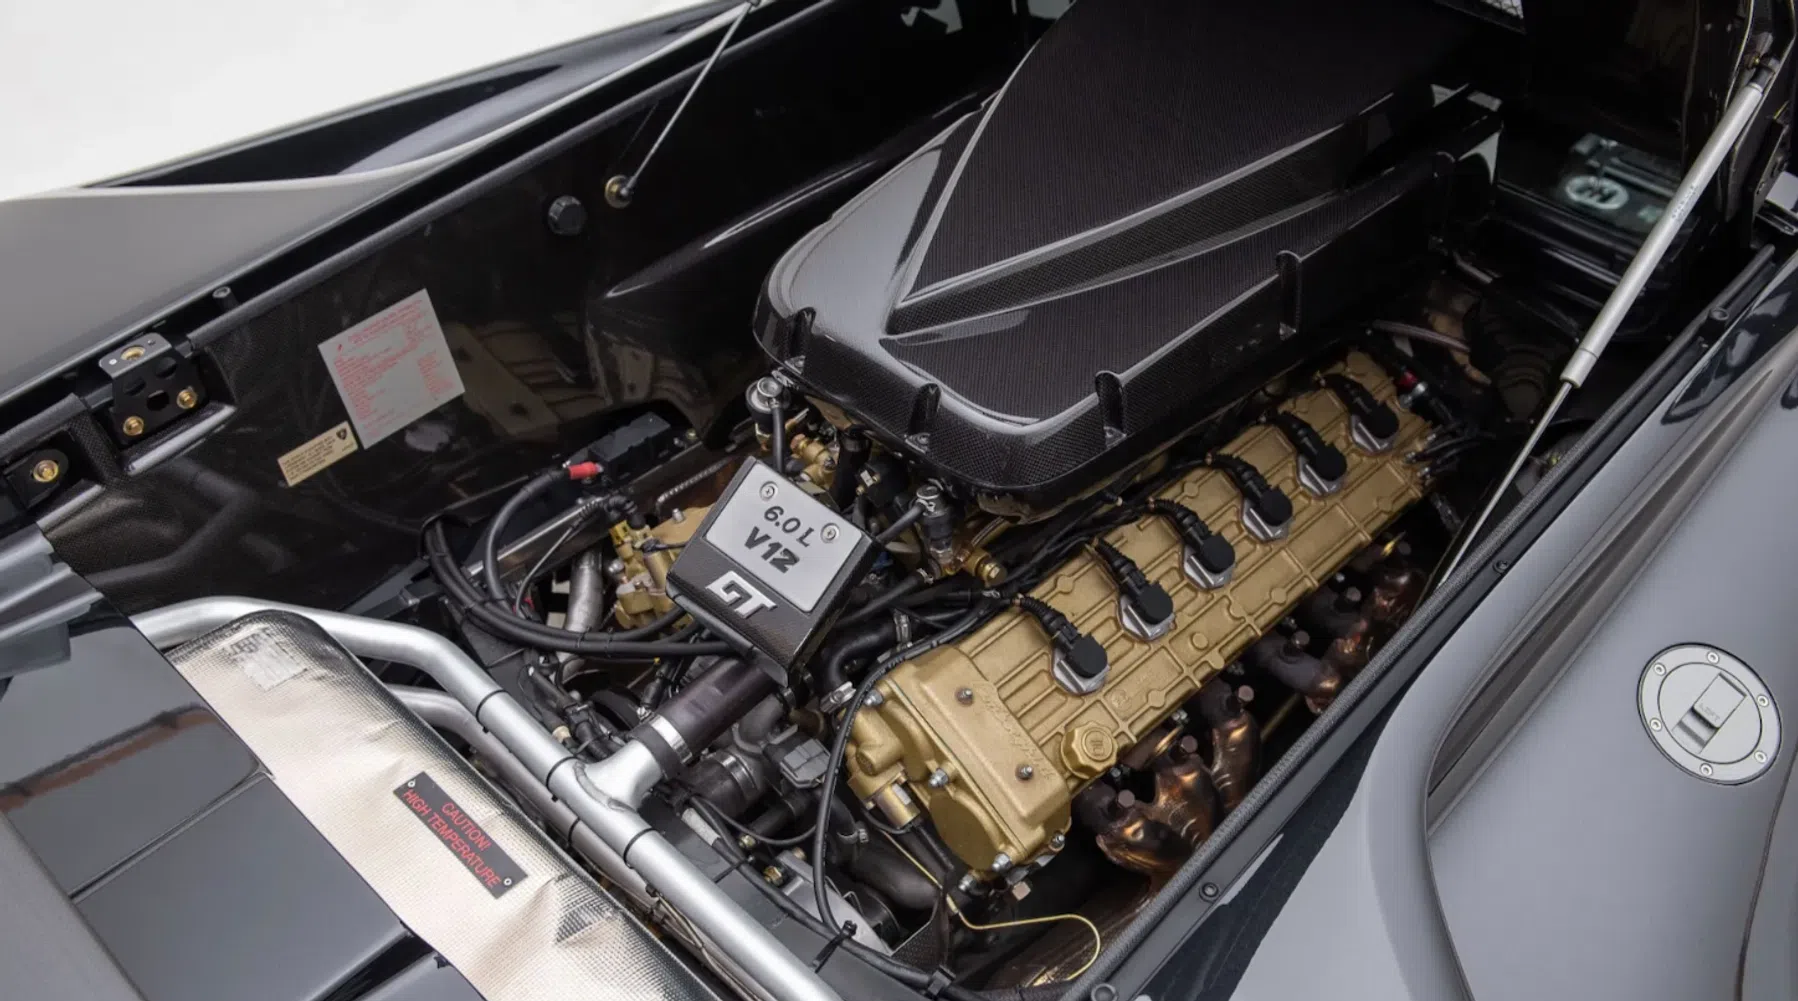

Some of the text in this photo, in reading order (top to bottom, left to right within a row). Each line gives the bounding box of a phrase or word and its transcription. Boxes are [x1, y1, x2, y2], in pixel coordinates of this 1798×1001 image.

[744, 526, 801, 574] V12
[764, 505, 815, 548] 6.0 L
[705, 570, 777, 619] GT
[403, 789, 502, 888] HIGH TEMPERATURE
[441, 802, 492, 851] CAUTION!
